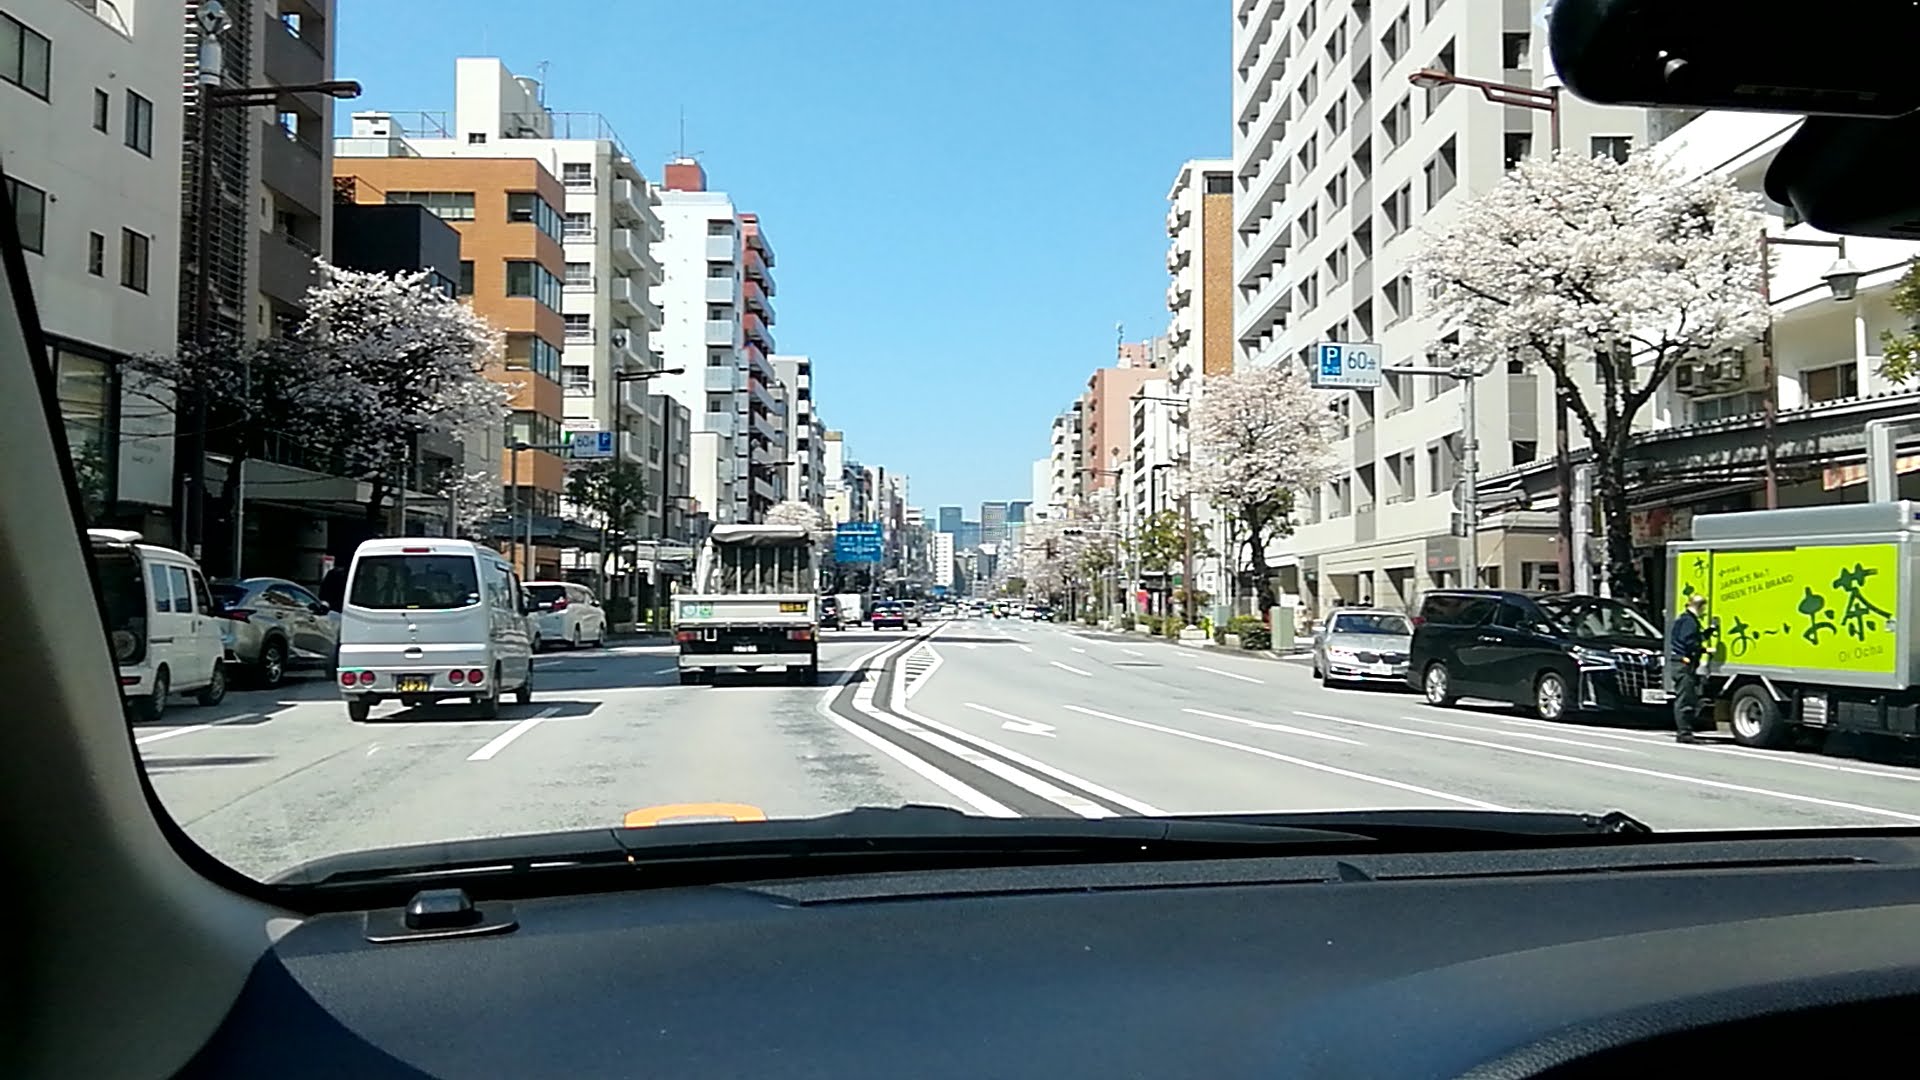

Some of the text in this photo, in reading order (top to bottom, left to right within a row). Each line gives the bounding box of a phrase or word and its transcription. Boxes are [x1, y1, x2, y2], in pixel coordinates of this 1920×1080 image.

[1326, 347, 1338, 365] P
[1720, 573, 1751, 590] JAPAN'S
[1720, 574, 1794, 602] GREEN TEA BRAND
